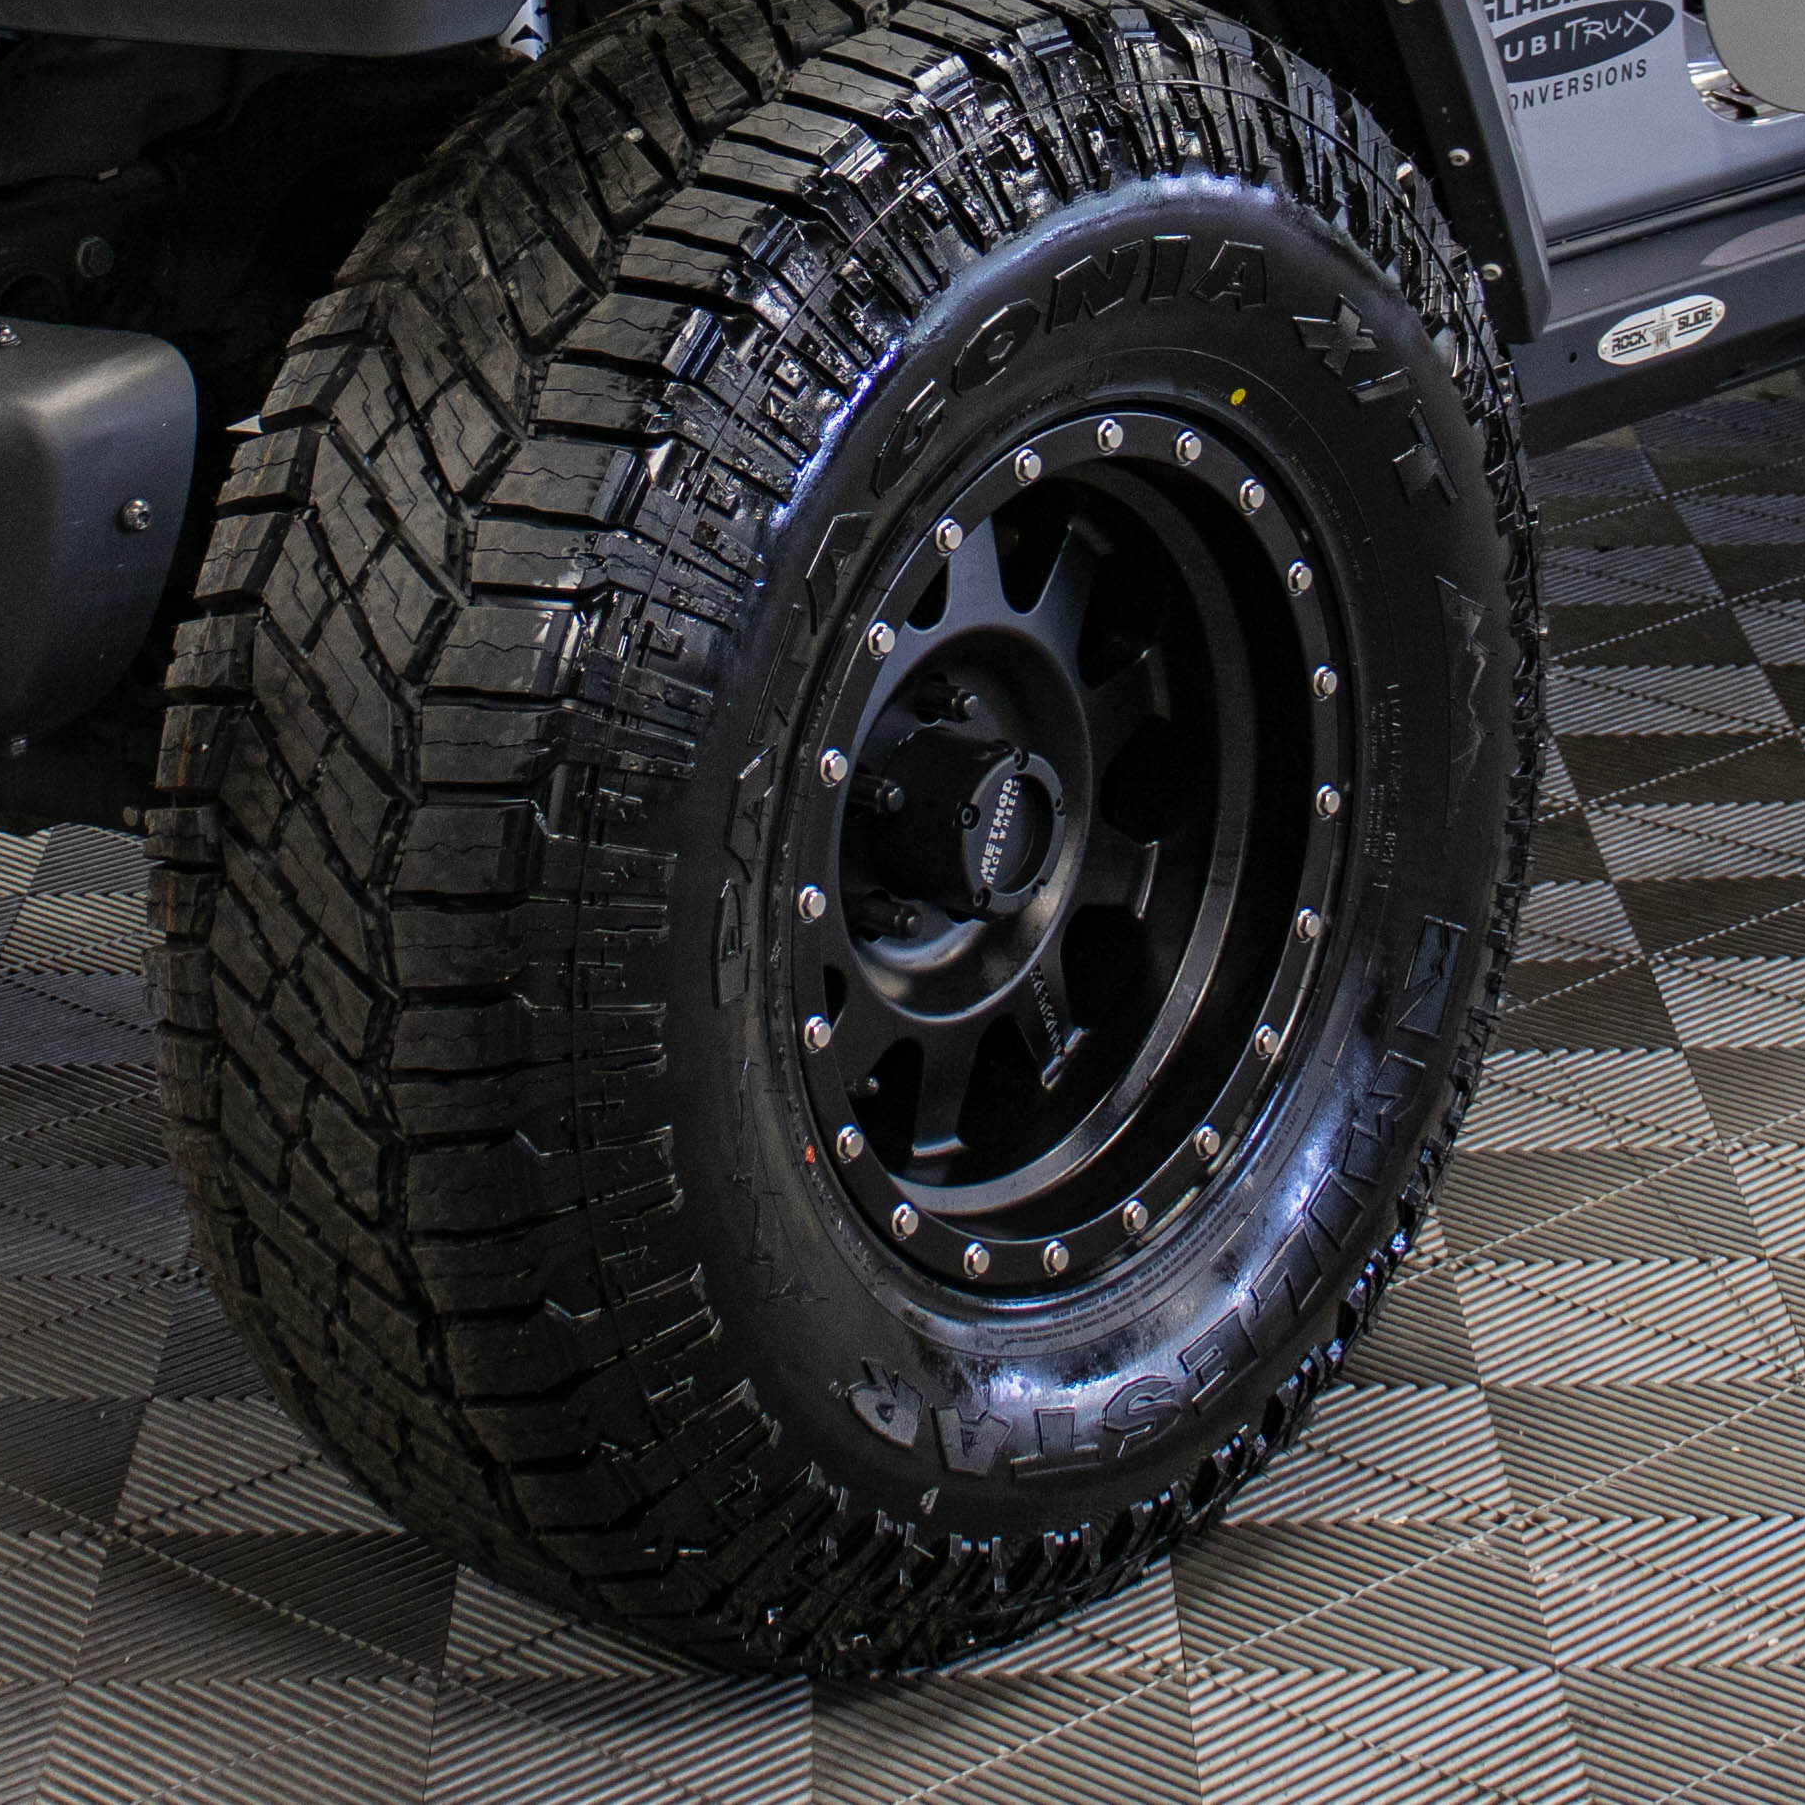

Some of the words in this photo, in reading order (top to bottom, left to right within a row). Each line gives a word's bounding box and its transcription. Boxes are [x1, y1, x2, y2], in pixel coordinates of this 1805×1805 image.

[1503, 7, 1655, 63] UBITRUX
[1509, 59, 1647, 111] ONVERSIONS
[1611, 329, 1648, 353] ROCK
[1677, 307, 1713, 331] SLIDE
[980, 778, 1013, 885] METHOD
[985, 846, 1003, 885] RACE
[846, 1050, 1428, 1478] MILESTAR
